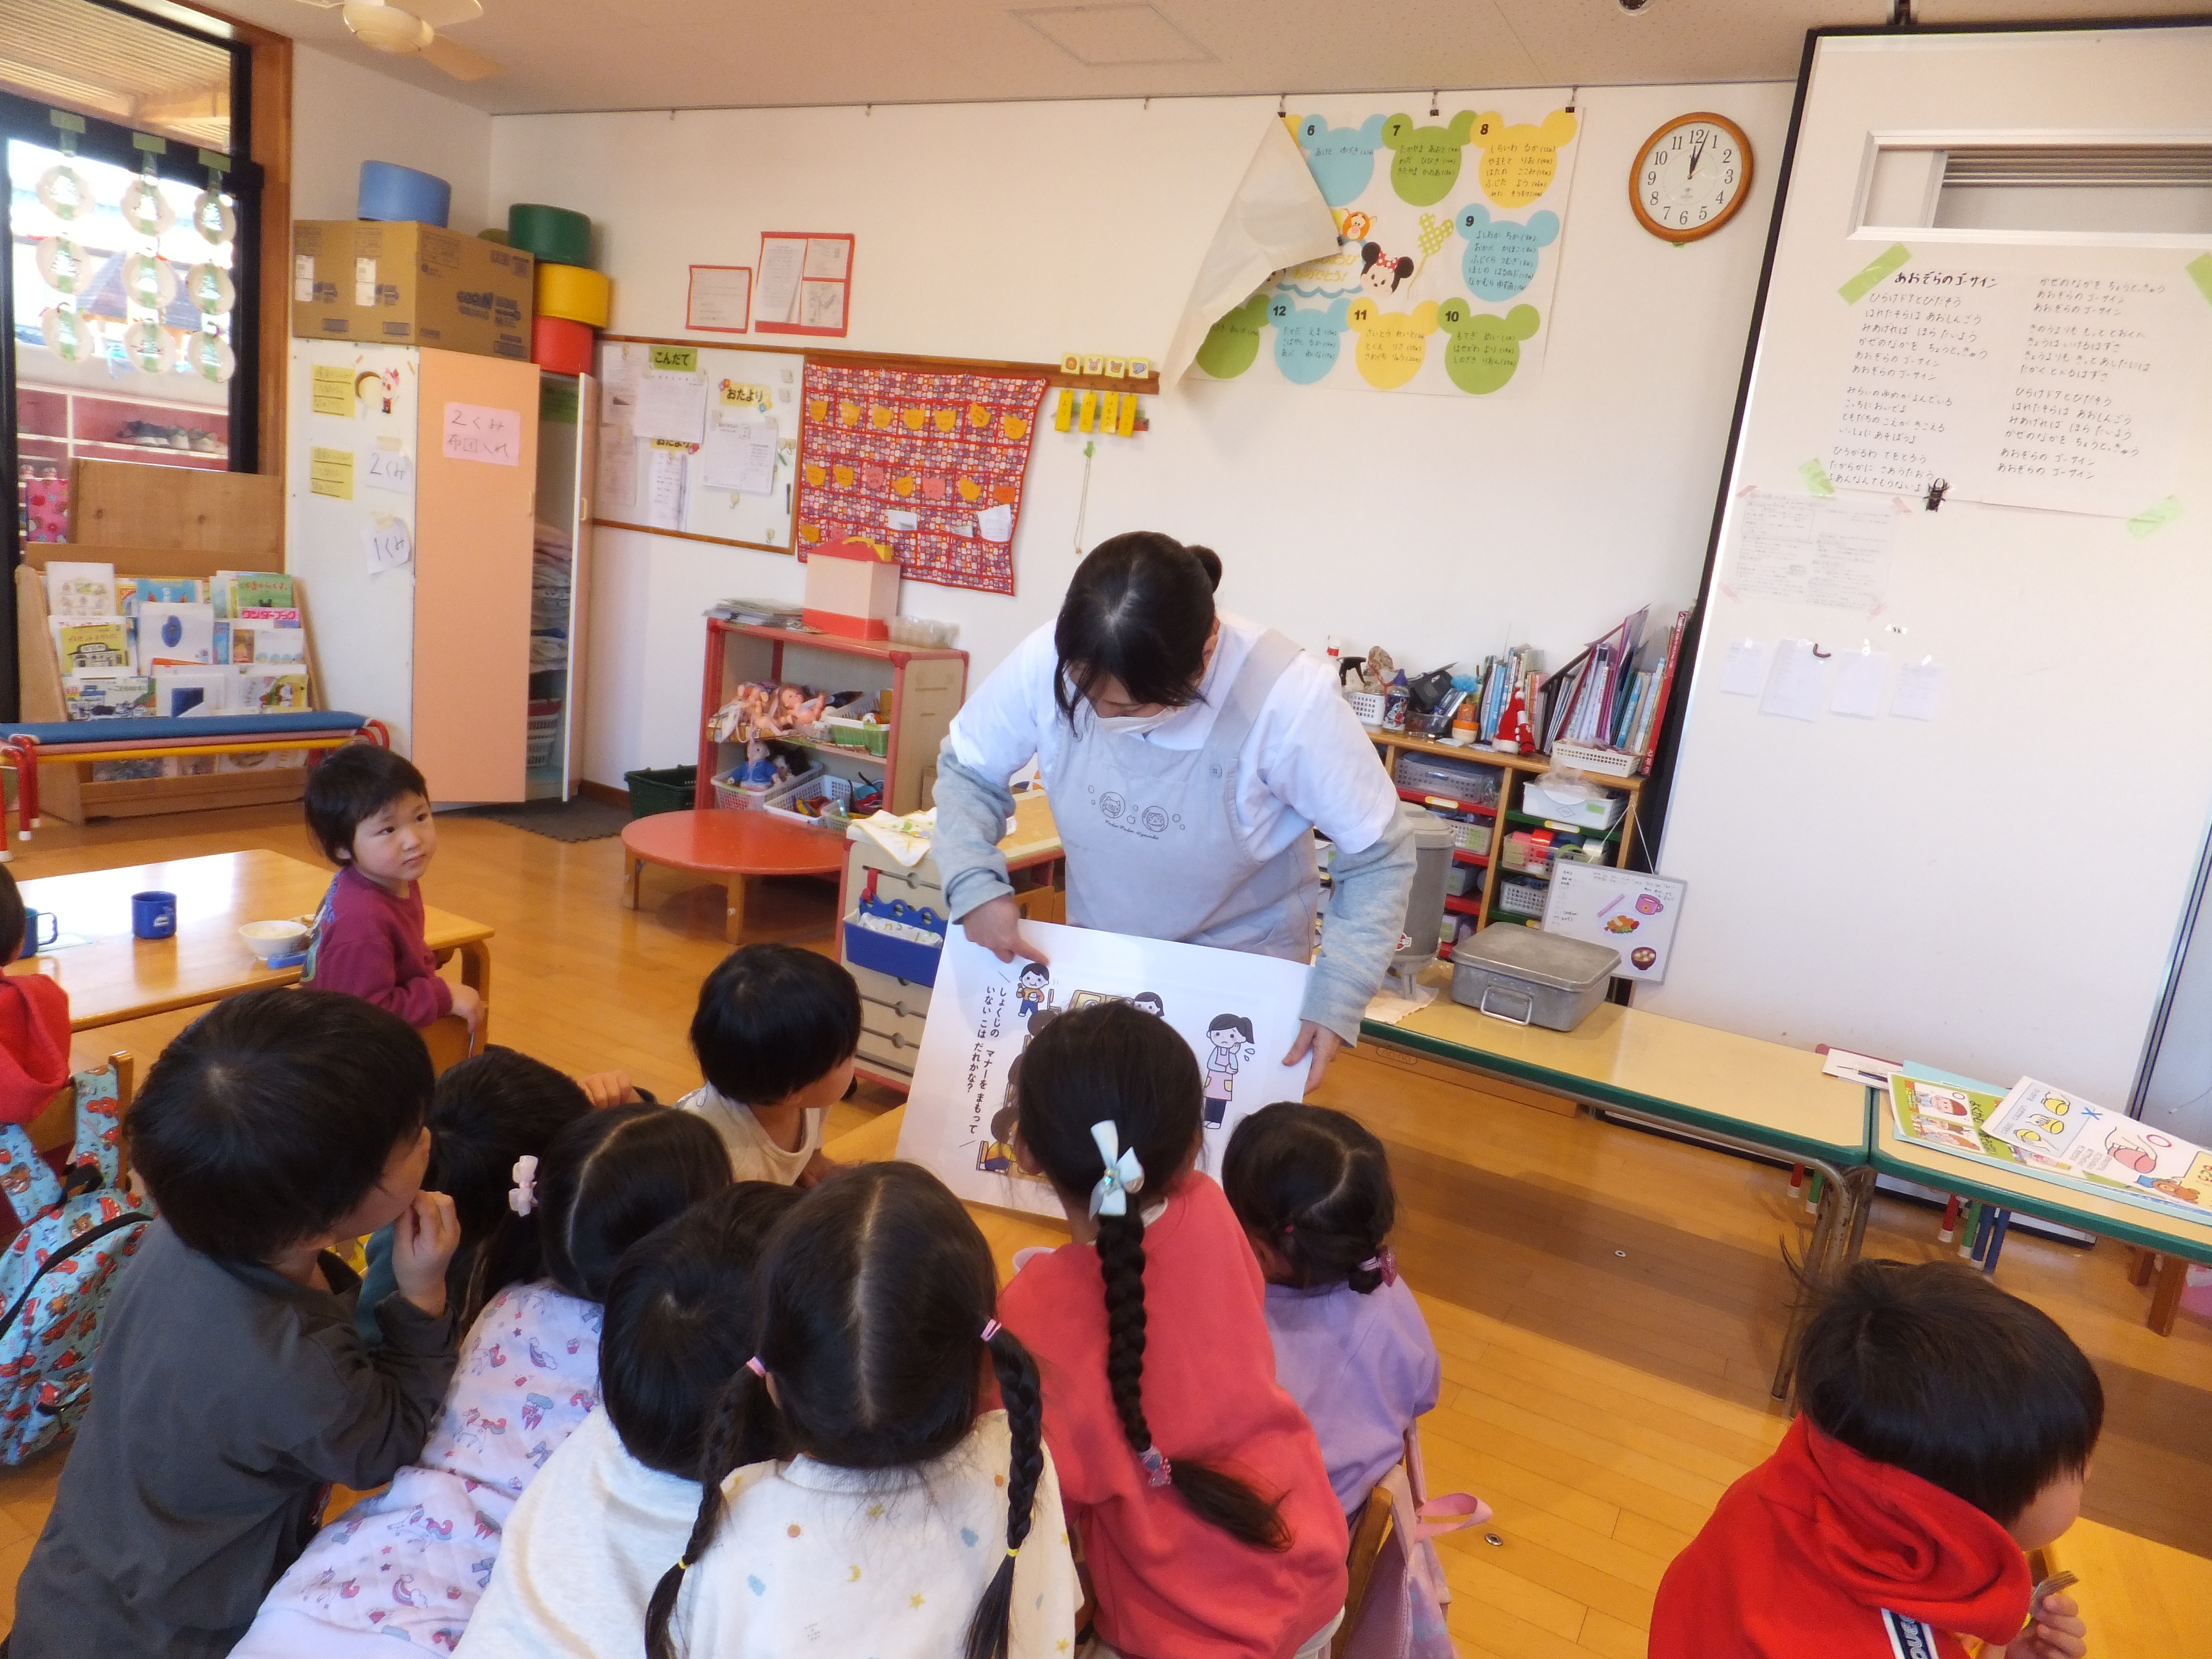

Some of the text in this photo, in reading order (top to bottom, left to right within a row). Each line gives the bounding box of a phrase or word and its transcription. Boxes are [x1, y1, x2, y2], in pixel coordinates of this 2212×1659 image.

[1307, 125, 1315, 136] 6
[1393, 124, 1401, 136] 7
[1480, 124, 1489, 135] 8
[1689, 129, 1704, 144] 12
[1672, 136, 1683, 150] 11
[1712, 135, 1717, 149] 1
[1654, 151, 1668, 166] 10
[1722, 149, 1731, 163] 2
[1647, 171, 1656, 186] 9
[1724, 169, 1733, 184] 3
[1650, 191, 1659, 205] 8
[1716, 190, 1724, 204] 4
[1663, 206, 1671, 220] 7
[1679, 211, 1688, 225] 6
[1699, 206, 1707, 220] 5
[1466, 216, 1474, 227] 9
[1895, 271, 1998, 288] あおぞらのゴーサイン
[1273, 305, 1286, 316] 12
[1354, 310, 1367, 320] 11
[1445, 311, 1459, 322] 10
[655, 351, 690, 366] こんだて
[727, 387, 763, 402] おたより
[452, 410, 504, 431] 2くみ
[370, 453, 406, 480] 2くみ
[967, 986, 995, 1092] いない こは だれかな?
[969, 987, 1007, 1134] しょくじの マナーを まもって
